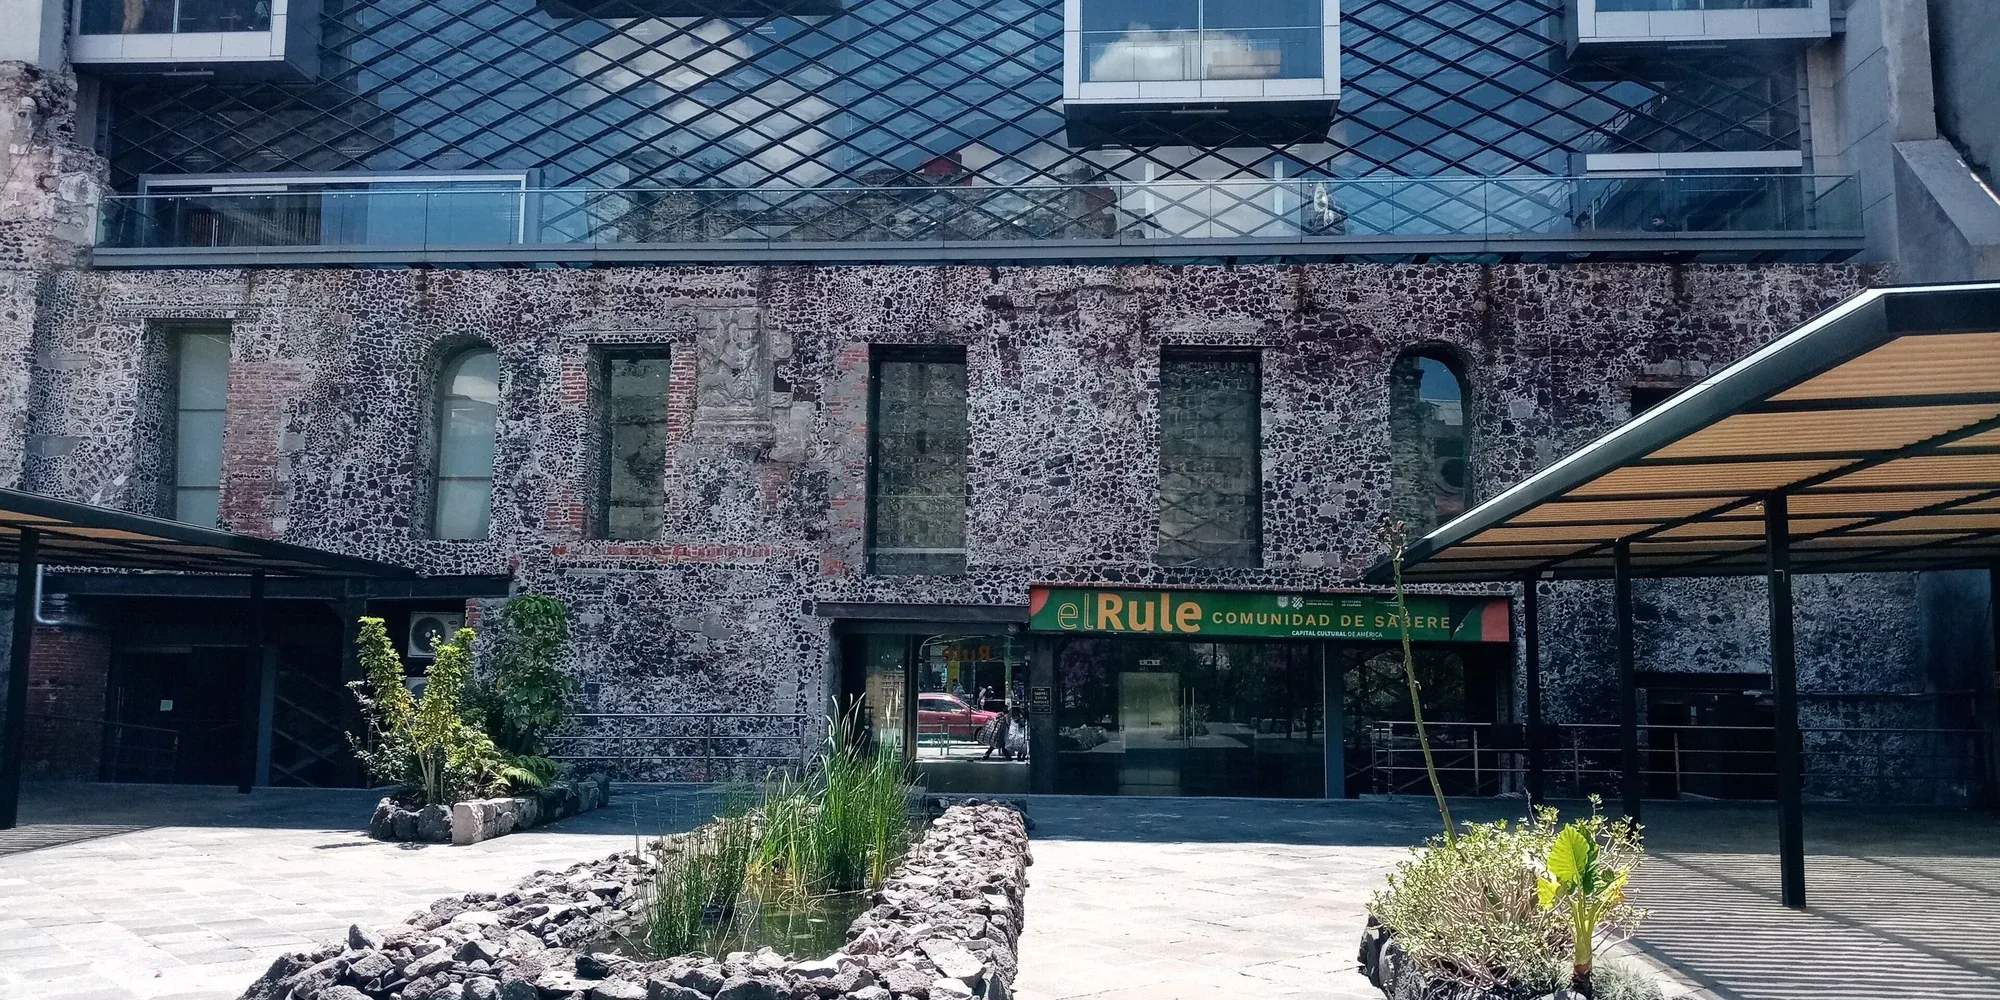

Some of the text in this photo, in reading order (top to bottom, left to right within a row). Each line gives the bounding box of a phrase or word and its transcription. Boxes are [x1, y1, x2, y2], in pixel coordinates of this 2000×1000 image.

[1212, 611, 1330, 626] COMUNIDAD
[1340, 614, 1365, 627] DE
[1356, 630, 1383, 638] AMÉRICA
